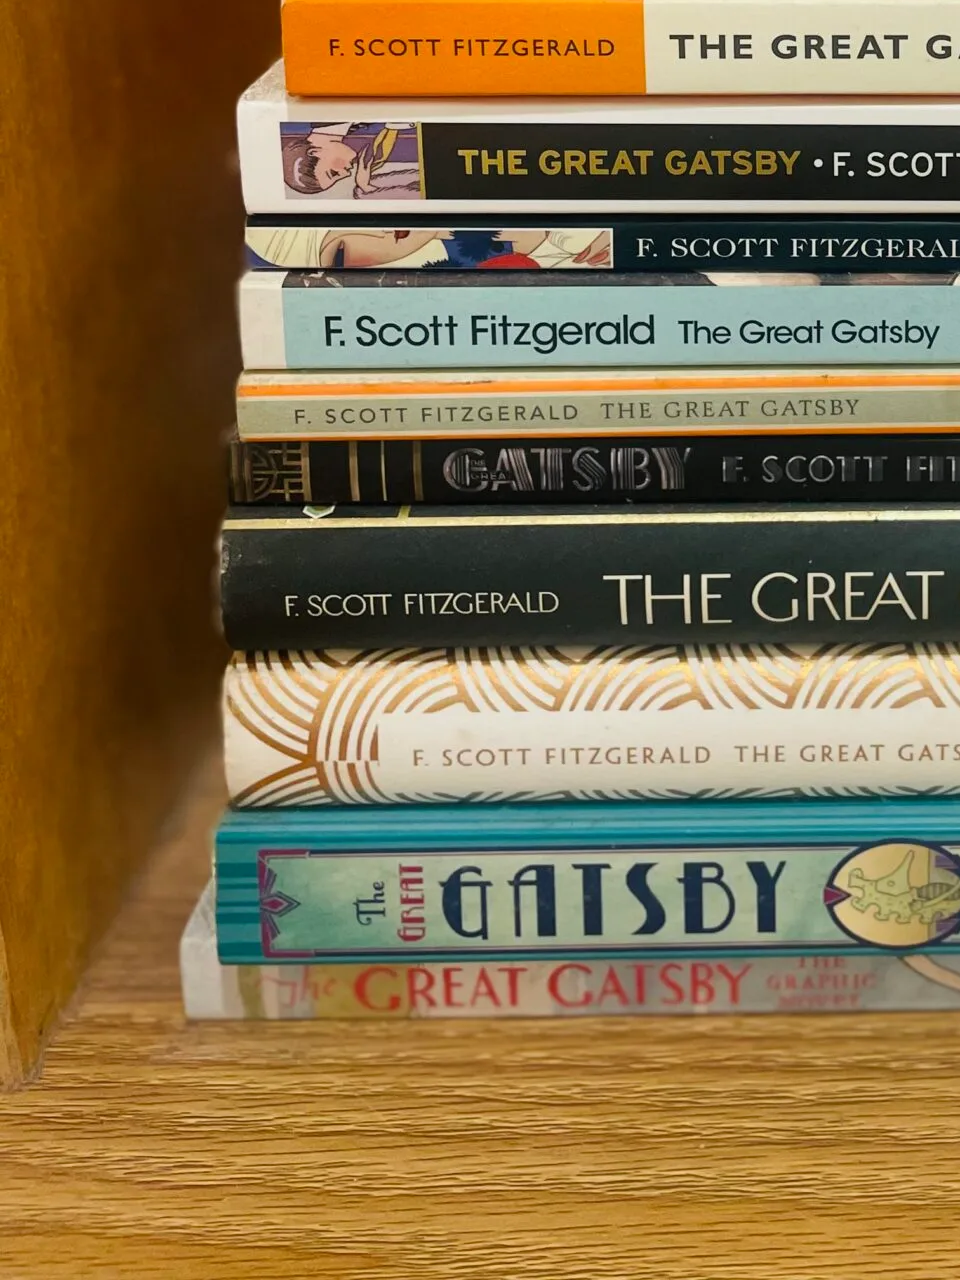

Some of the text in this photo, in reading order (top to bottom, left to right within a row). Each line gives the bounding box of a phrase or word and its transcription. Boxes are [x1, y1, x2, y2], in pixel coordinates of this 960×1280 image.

[330, 39, 614, 56] F. SCOTT FITZGERALD
[670, 35, 752, 59] THE
[771, 35, 909, 60] GREAT
[458, 150, 528, 174] THE
[539, 150, 653, 175] GREAT
[665, 150, 800, 175] GATSBY
[834, 152, 854, 176] F.
[638, 239, 657, 257] F.
[672, 238, 778, 257] SCOTT
[325, 315, 939, 354] F. Scott Fitzgerald The Great Gatsby
[295, 400, 858, 424] F. SCOTT FITZGERALD THE GREAT GATSBY
[442, 446, 692, 493] GATSBY
[723, 457, 746, 481] F.
[763, 455, 887, 482] SCOTT
[285, 596, 298, 616] F.
[308, 594, 391, 616] SCOTT
[405, 592, 558, 614] FITZGERALD
[603, 574, 731, 624] THE
[752, 571, 944, 621] GREAT
[414, 750, 427, 766] F.
[443, 749, 530, 766] SCOTT
[546, 747, 710, 764] FITZGERALD
[735, 746, 784, 762] THE
[800, 745, 884, 762] GREAT
[356, 880, 386, 925] The
[397, 863, 425, 942] GREAT
[440, 861, 786, 939] GATSBY
[353, 966, 528, 1012] GREAT
[547, 964, 752, 1008] GATSBY
[767, 973, 878, 991] GRAPHIC
